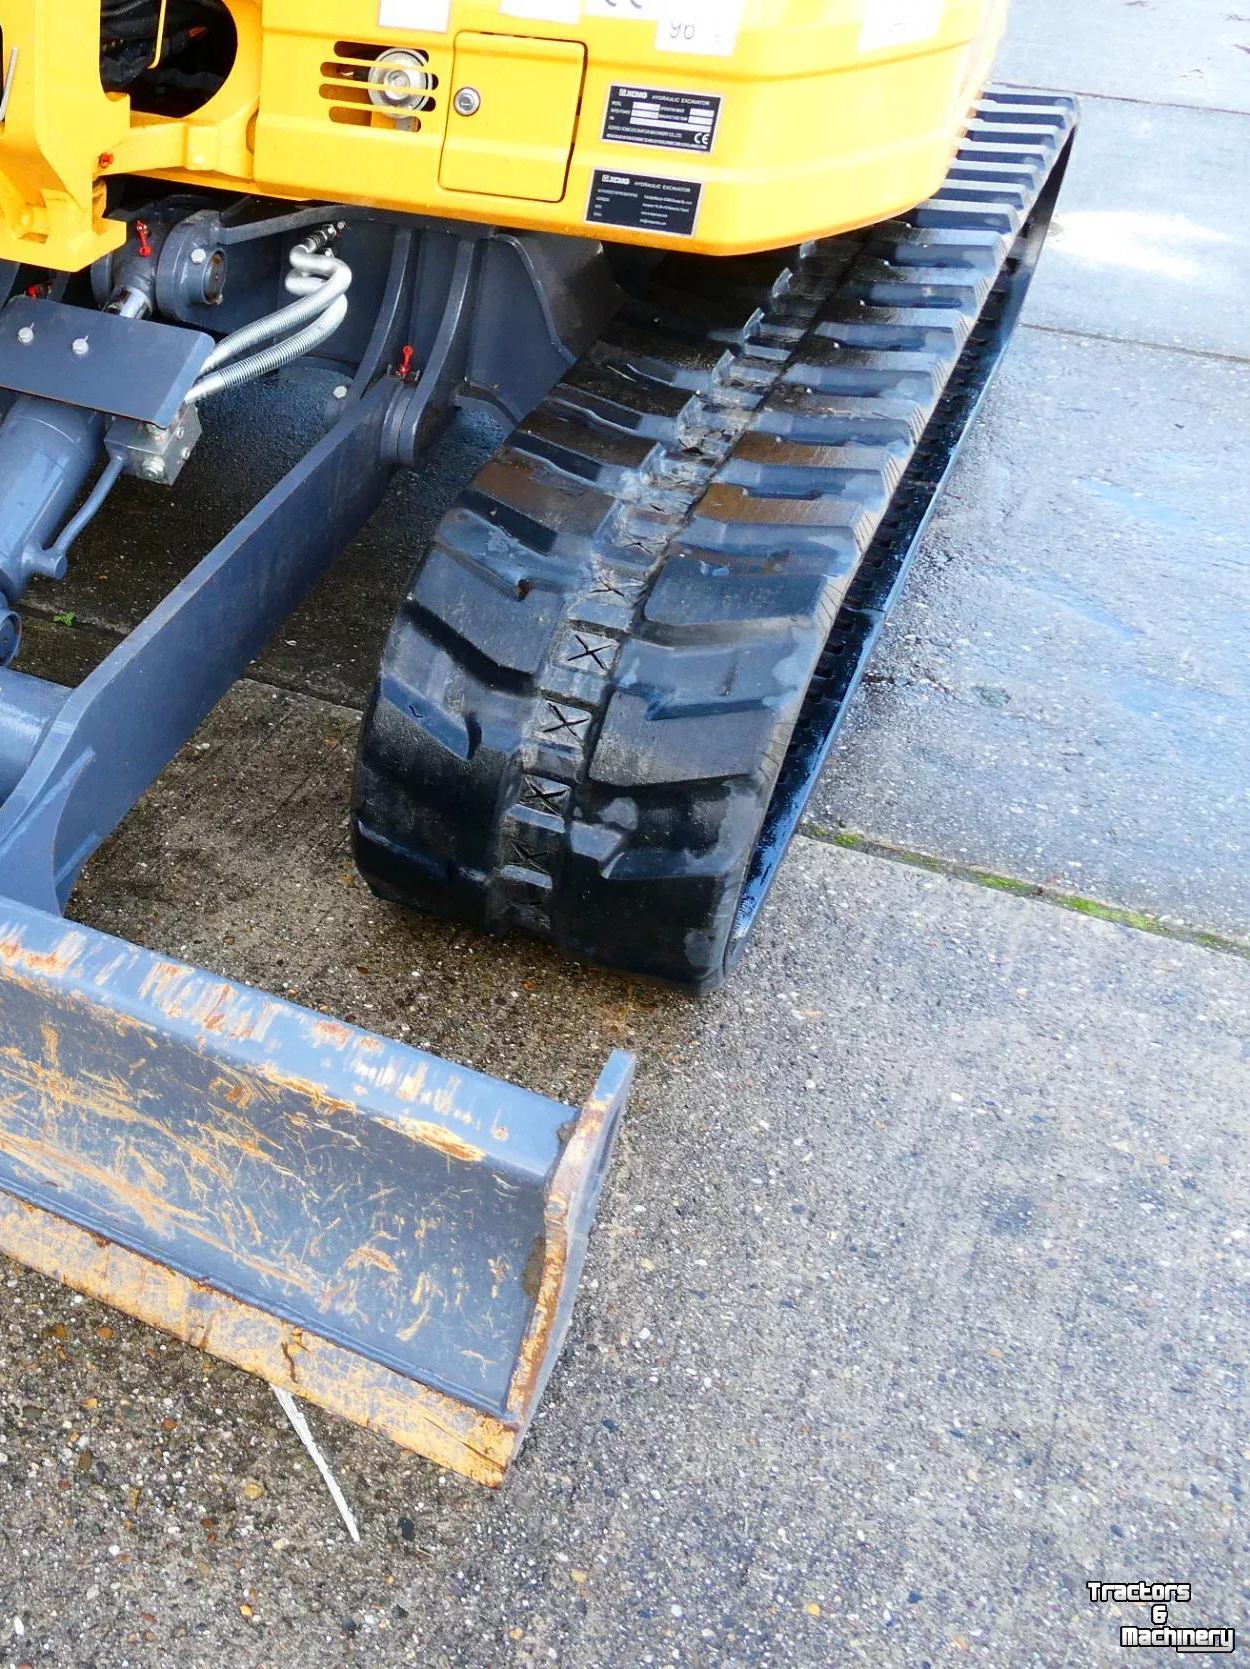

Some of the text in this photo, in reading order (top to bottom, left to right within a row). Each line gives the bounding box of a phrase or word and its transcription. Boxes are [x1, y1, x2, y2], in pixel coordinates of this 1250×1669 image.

[652, 94, 680, 104] HYDRAULIC
[680, 98, 711, 106] EXCAVATOR
[634, 181, 662, 190] HYDRAULIC
[662, 184, 691, 193] EXCAVATOR
